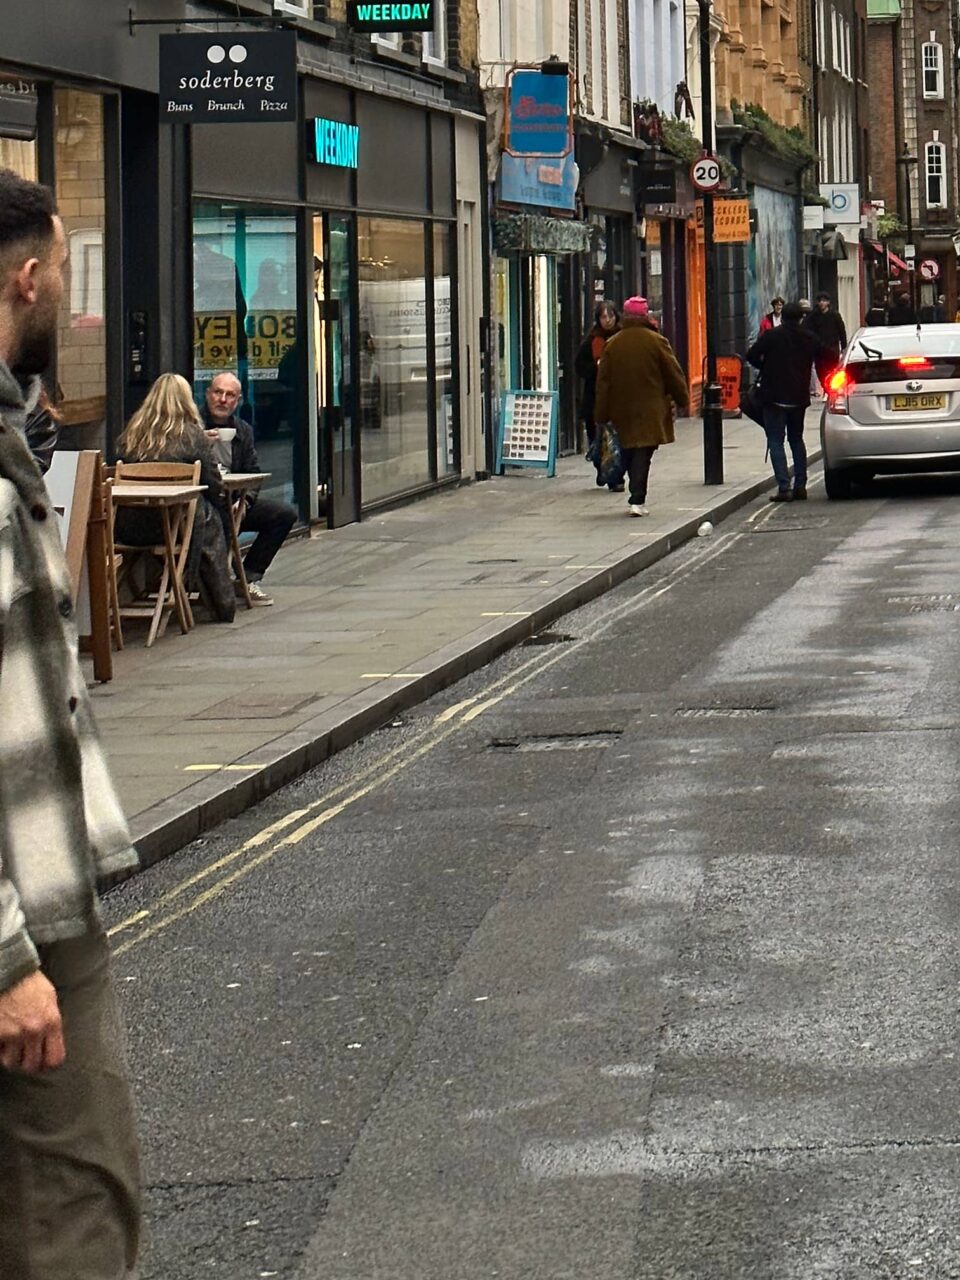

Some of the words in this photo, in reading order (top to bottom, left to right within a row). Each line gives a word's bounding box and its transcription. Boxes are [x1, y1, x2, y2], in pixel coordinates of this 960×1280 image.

[356, 3, 431, 21] WEEKDAY
[179, 70, 275, 91] soderberg
[167, 100, 194, 112] Buns
[207, 98, 245, 111] Brunch
[260, 99, 288, 111] Pizza
[314, 116, 359, 169] WEEKDAY
[696, 166, 719, 180] 20
[714, 204, 748, 215] CKLESS
